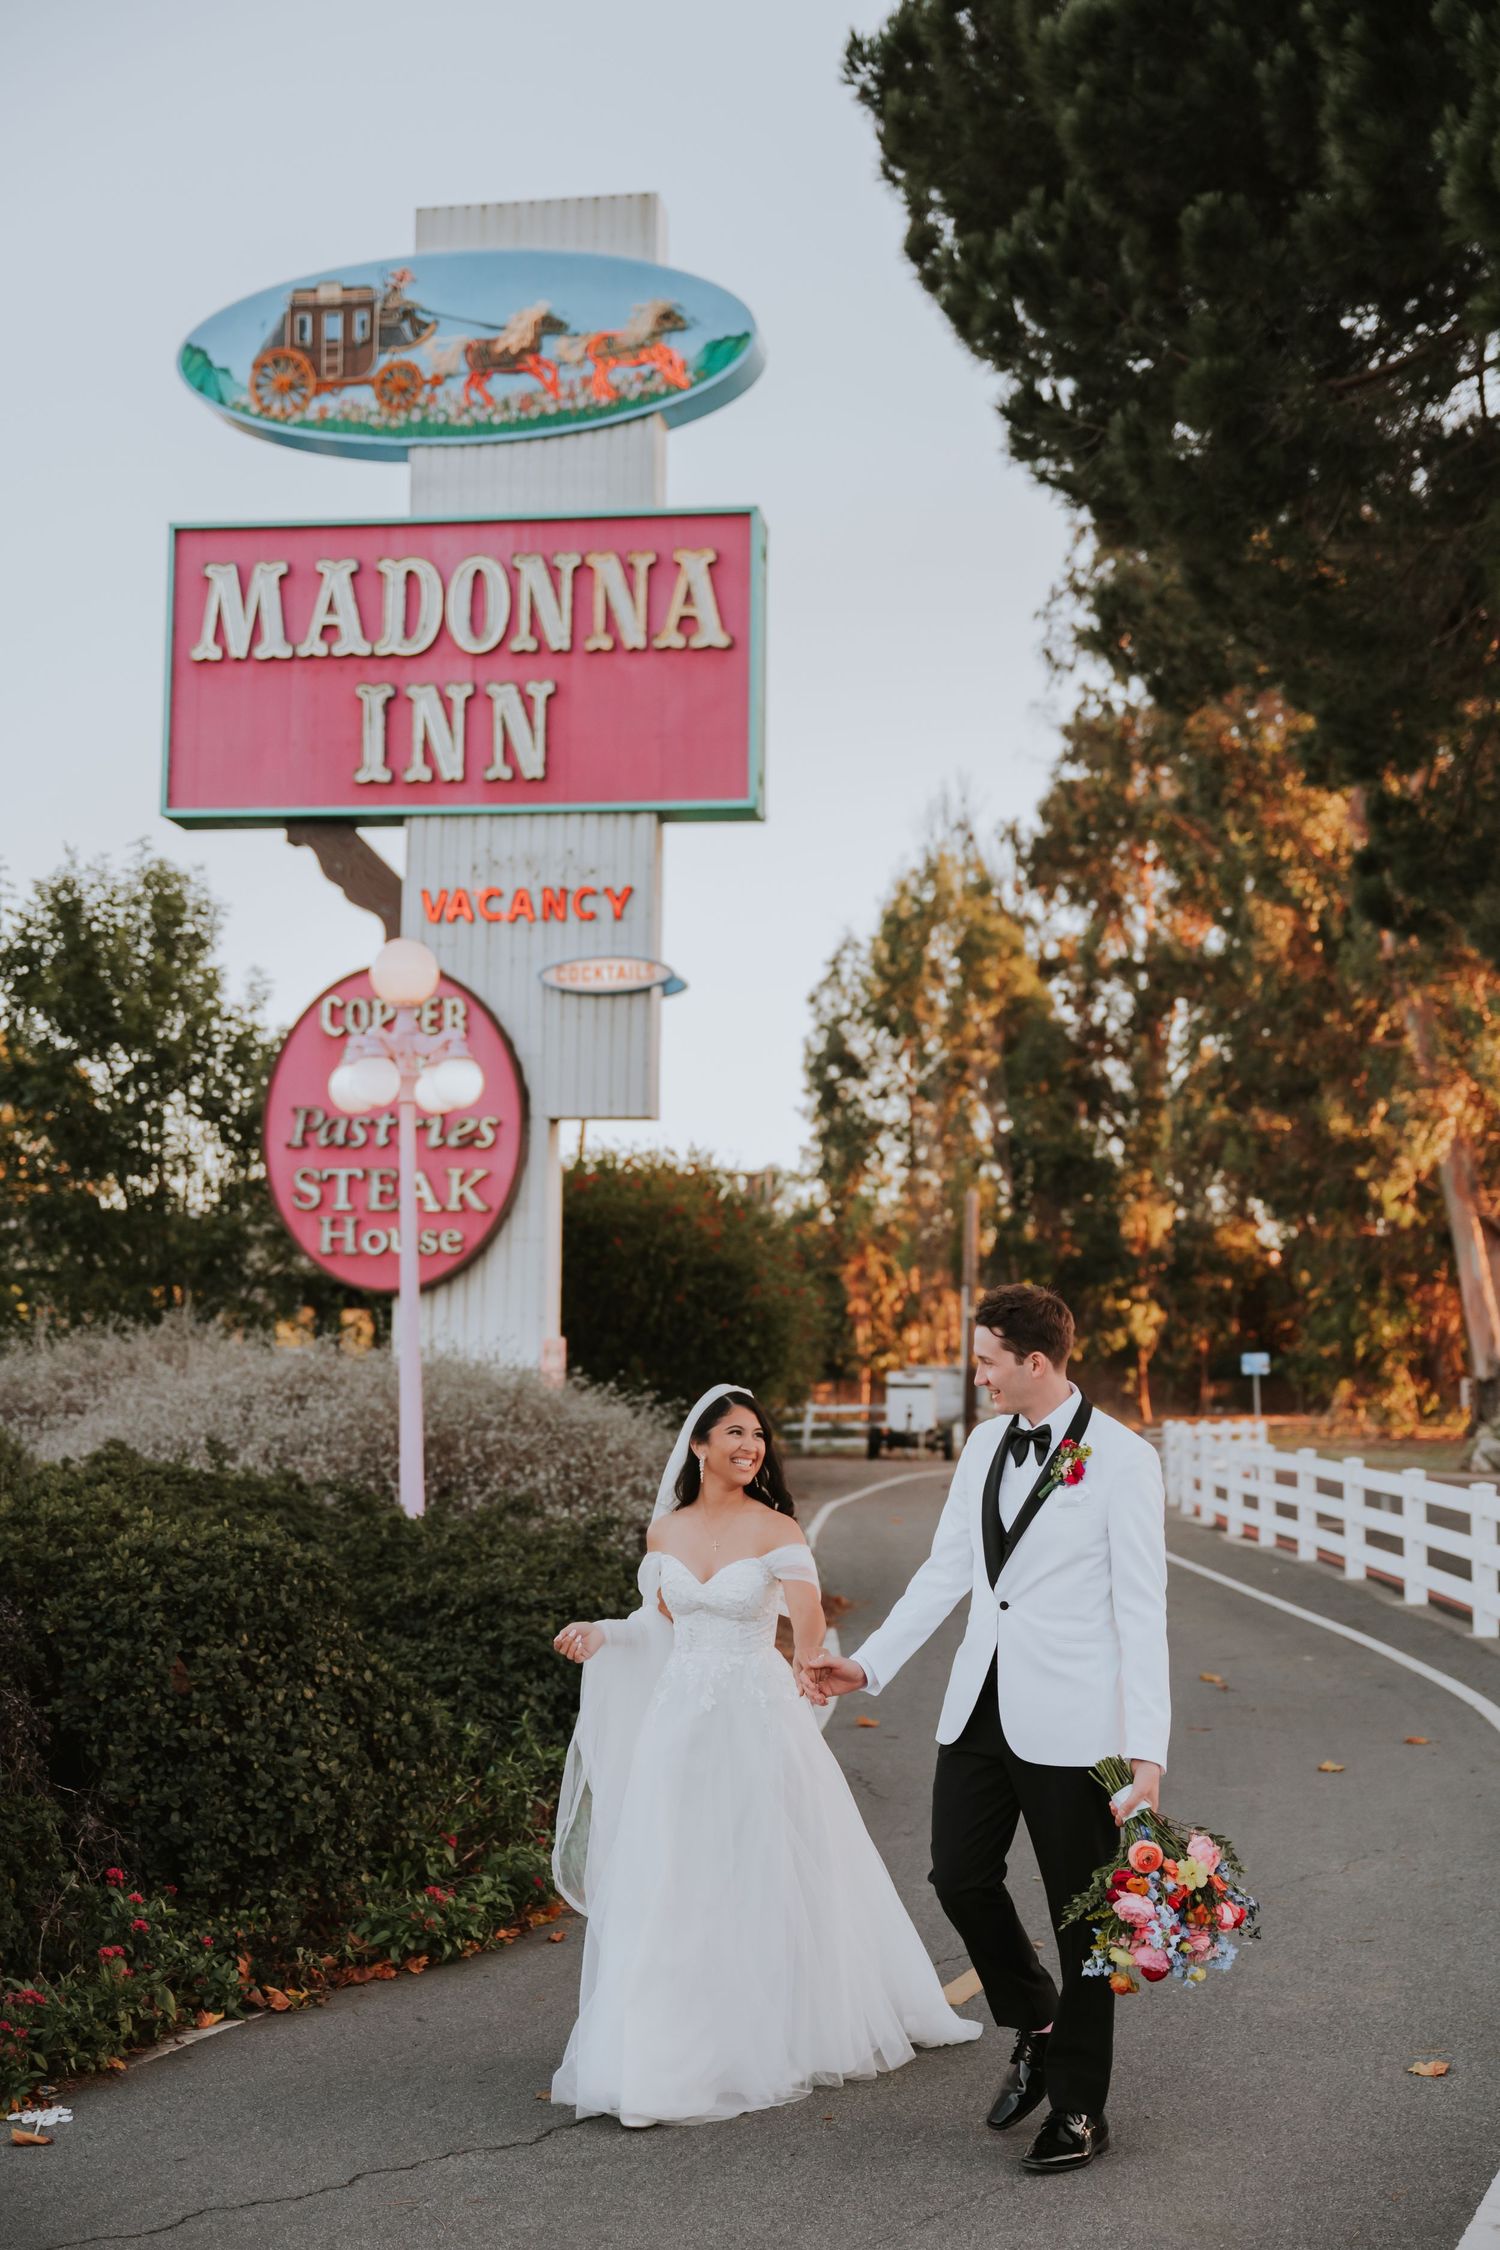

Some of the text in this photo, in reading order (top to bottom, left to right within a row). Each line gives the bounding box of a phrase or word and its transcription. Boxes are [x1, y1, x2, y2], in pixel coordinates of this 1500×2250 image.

[190, 548, 733, 661] MADONNA
[355, 680, 555, 784] INN
[420, 884, 634, 923] VACANCY
[319, 994, 467, 1037] COPER
[292, 1167, 492, 1213] STEAK
